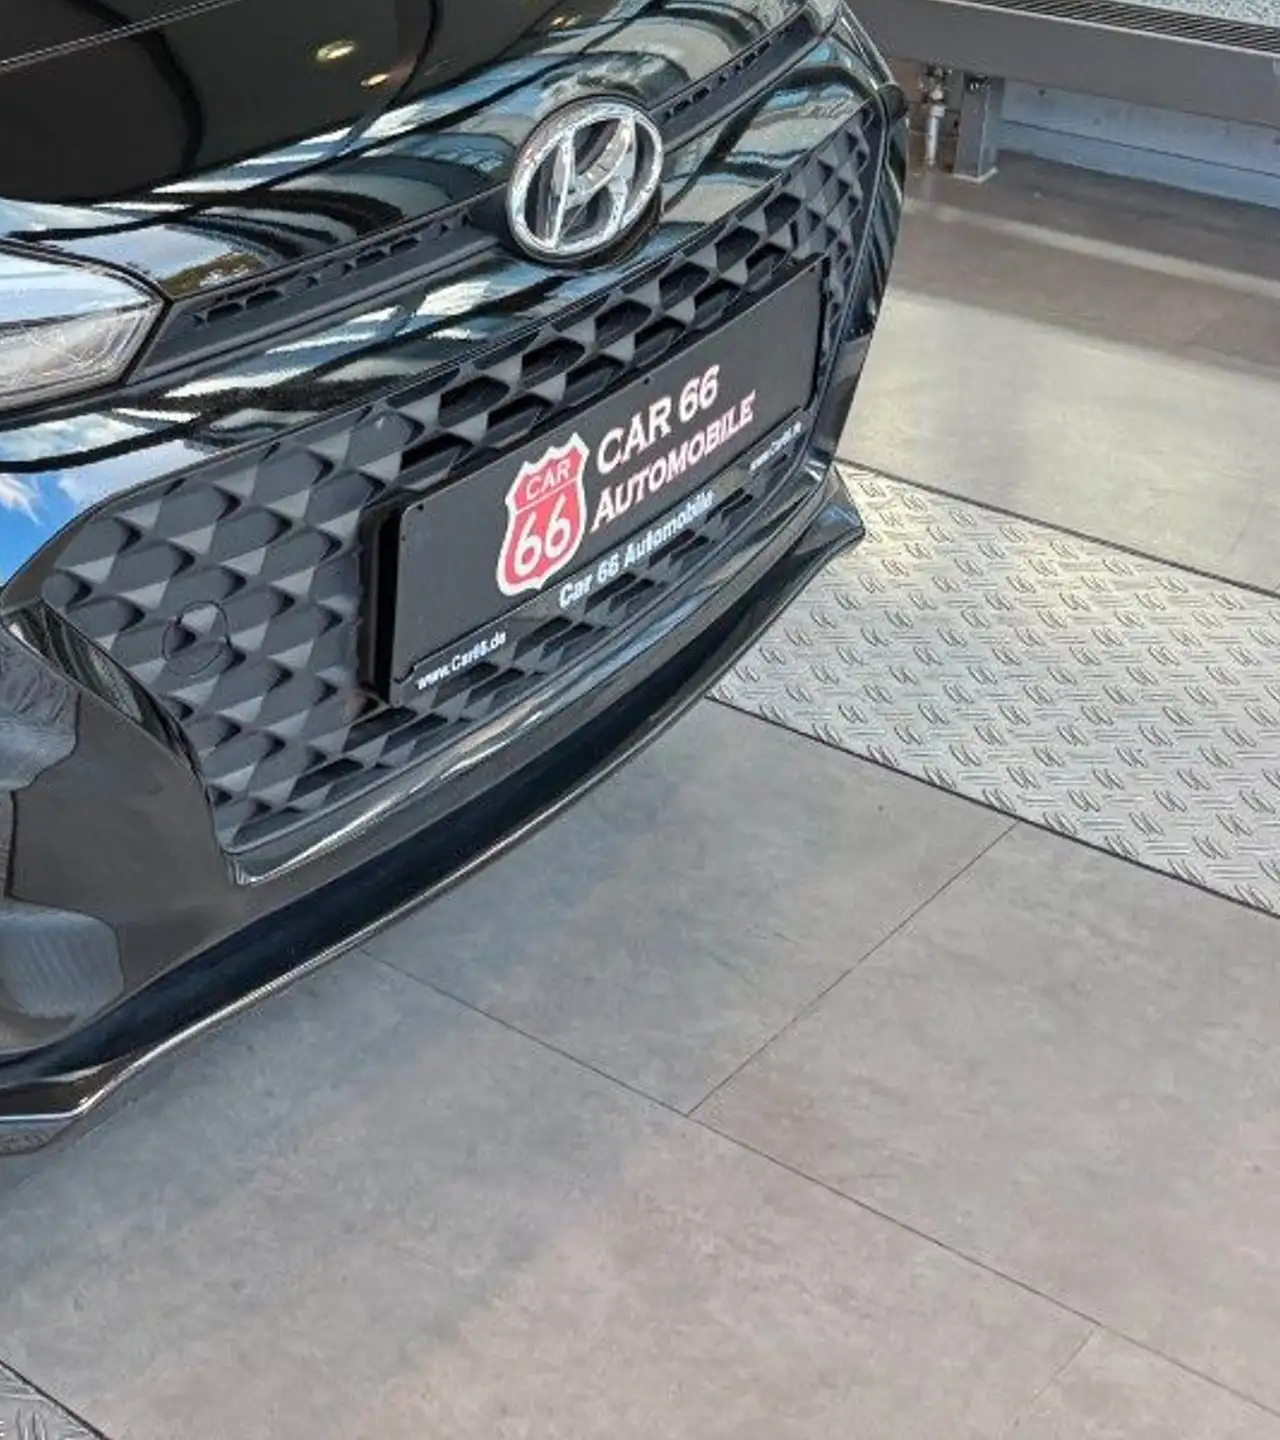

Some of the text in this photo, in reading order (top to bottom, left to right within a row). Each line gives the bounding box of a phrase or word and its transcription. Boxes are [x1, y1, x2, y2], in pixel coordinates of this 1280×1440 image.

[589, 389, 757, 533] AUTOMOBILE
[597, 363, 720, 474] CAR 66
[525, 459, 572, 501] CAR
[513, 492, 572, 578] 66
[559, 572, 593, 609] Car
[597, 552, 621, 583] 66
